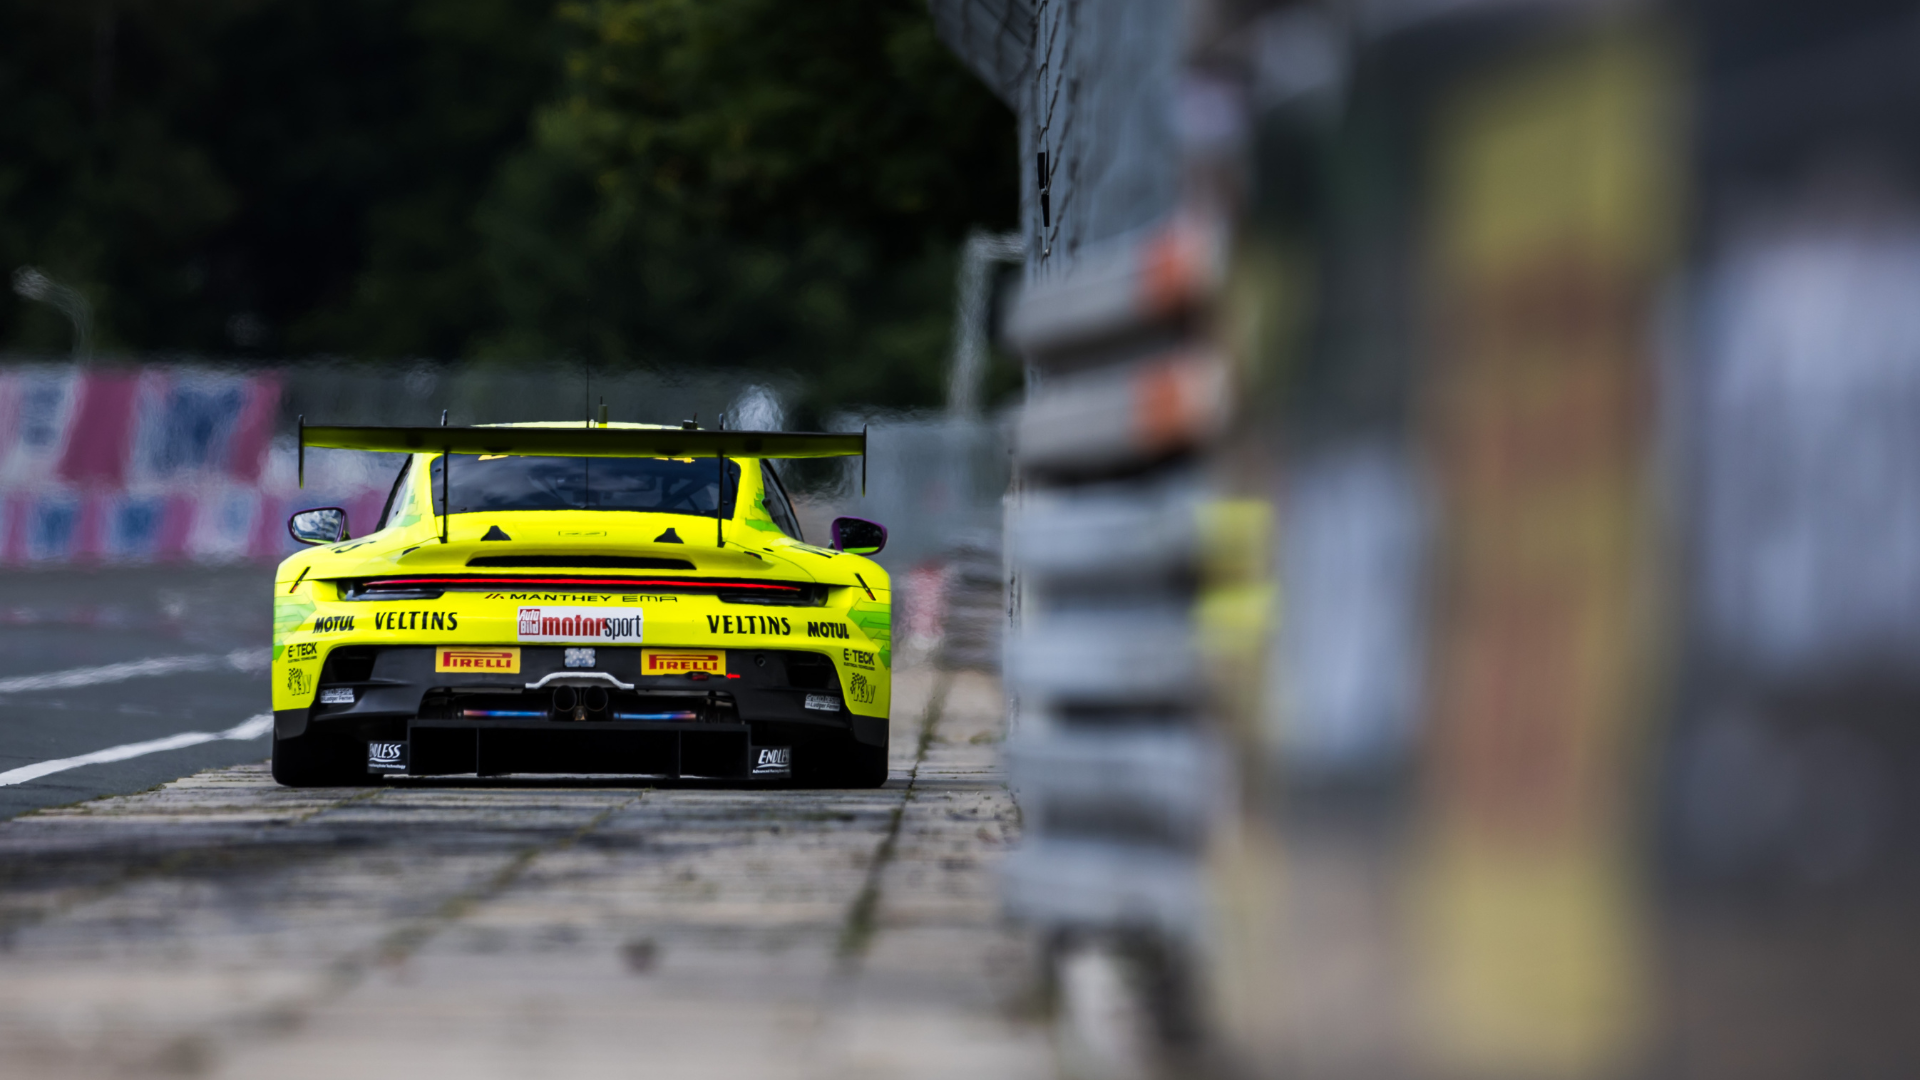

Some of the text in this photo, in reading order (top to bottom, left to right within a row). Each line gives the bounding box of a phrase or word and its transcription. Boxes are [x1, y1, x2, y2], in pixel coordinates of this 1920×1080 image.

[510, 593, 612, 602] MANTHEY
[313, 615, 355, 634] MOTUL
[375, 611, 458, 631] VELTINS
[706, 615, 791, 636] VELTINS
[807, 621, 850, 639] MOTUL
[443, 651, 513, 668] PIRELLI
[649, 654, 718, 670] PIRELLI
[757, 748, 790, 764] ENDLE
